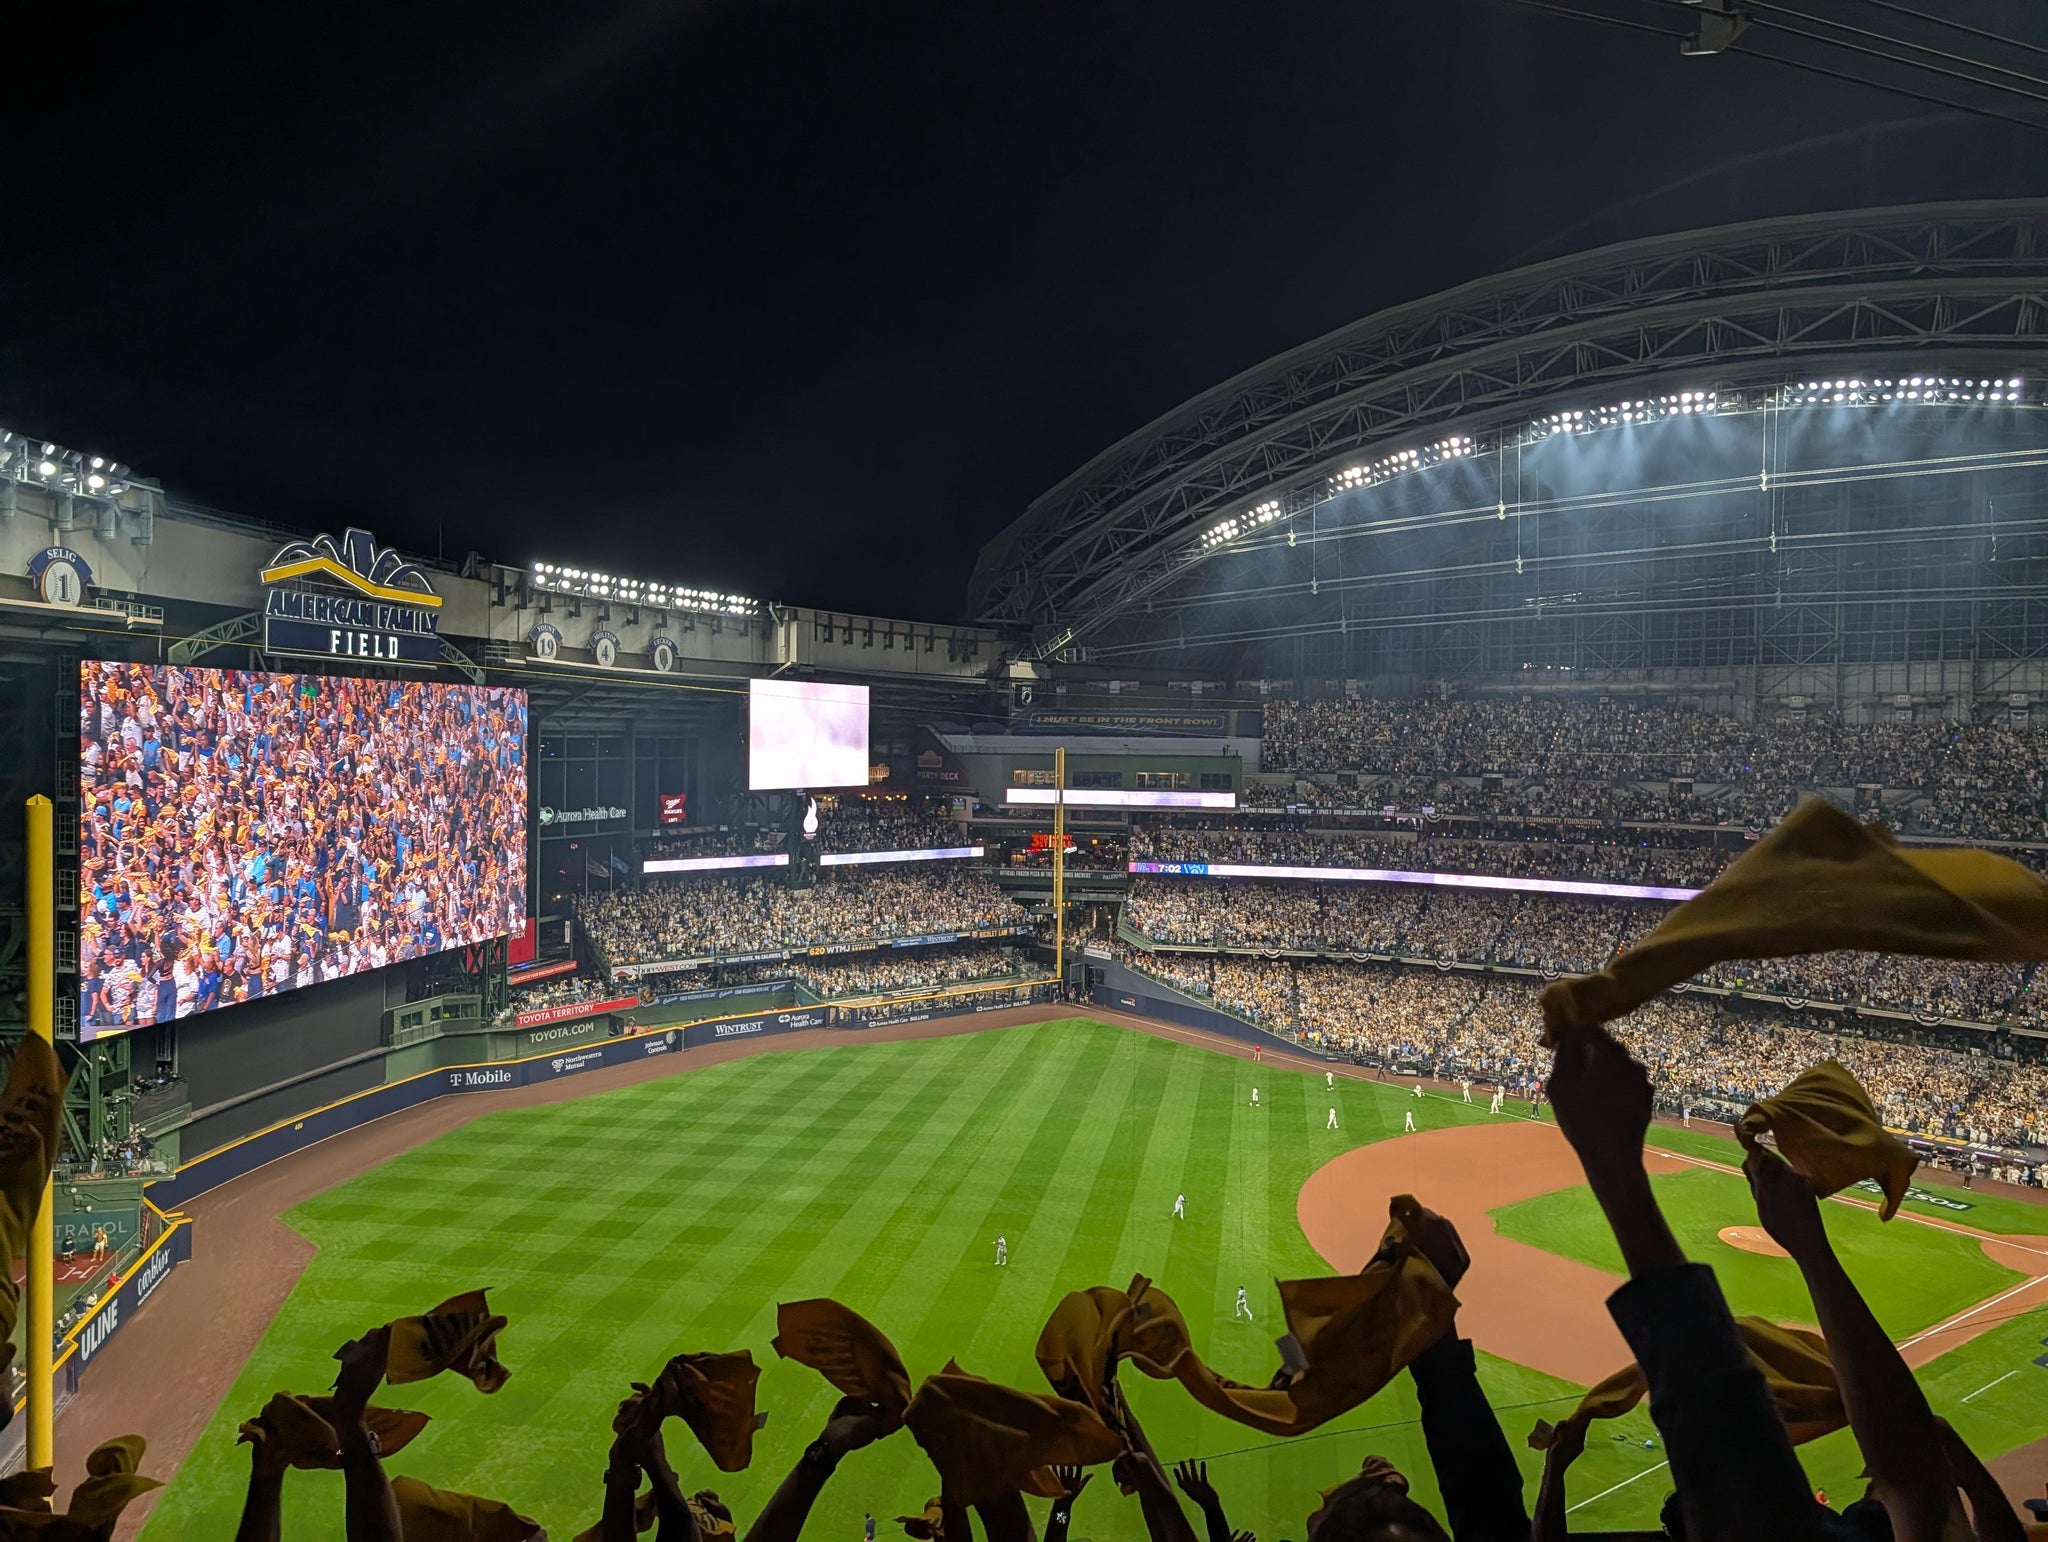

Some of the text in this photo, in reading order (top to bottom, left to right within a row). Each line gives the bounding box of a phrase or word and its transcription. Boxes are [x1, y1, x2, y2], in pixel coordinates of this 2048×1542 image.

[46, 548, 77, 563] SELIG
[58, 574, 71, 602] 1
[266, 589, 440, 635] AMERICAN FAMILY
[537, 624, 555, 634] YOUNT
[594, 631, 617, 643] MOLITOR
[331, 630, 399, 659] FIELD
[540, 638, 554, 656] 19
[601, 644, 609, 661] 4
[917, 770, 959, 781] PARTY DECK
[554, 806, 627, 823] Aurora Health Care
[1497, 815, 1602, 825] BREWERS COMMUNITY FOUNDATION
[1158, 864, 1181, 873] 7:02
[809, 944, 850, 956] 620 WTMJ
[519, 1004, 594, 1024] TOYOTA TERRITORY
[791, 1013, 810, 1021] Aurora
[715, 1021, 762, 1034] WINTRUST
[790, 1018, 823, 1028] Health Care
[530, 1022, 594, 1043] TOYOTA.COM
[645, 1040, 664, 1049] Johnson
[648, 1045, 668, 1054] Controls
[565, 1051, 602, 1064] Northwestern
[565, 1060, 585, 1071] Mutual
[465, 1069, 512, 1086] Mobile
[54, 1220, 128, 1238] TRAFOL
[81, 1298, 118, 1361] ULINE
